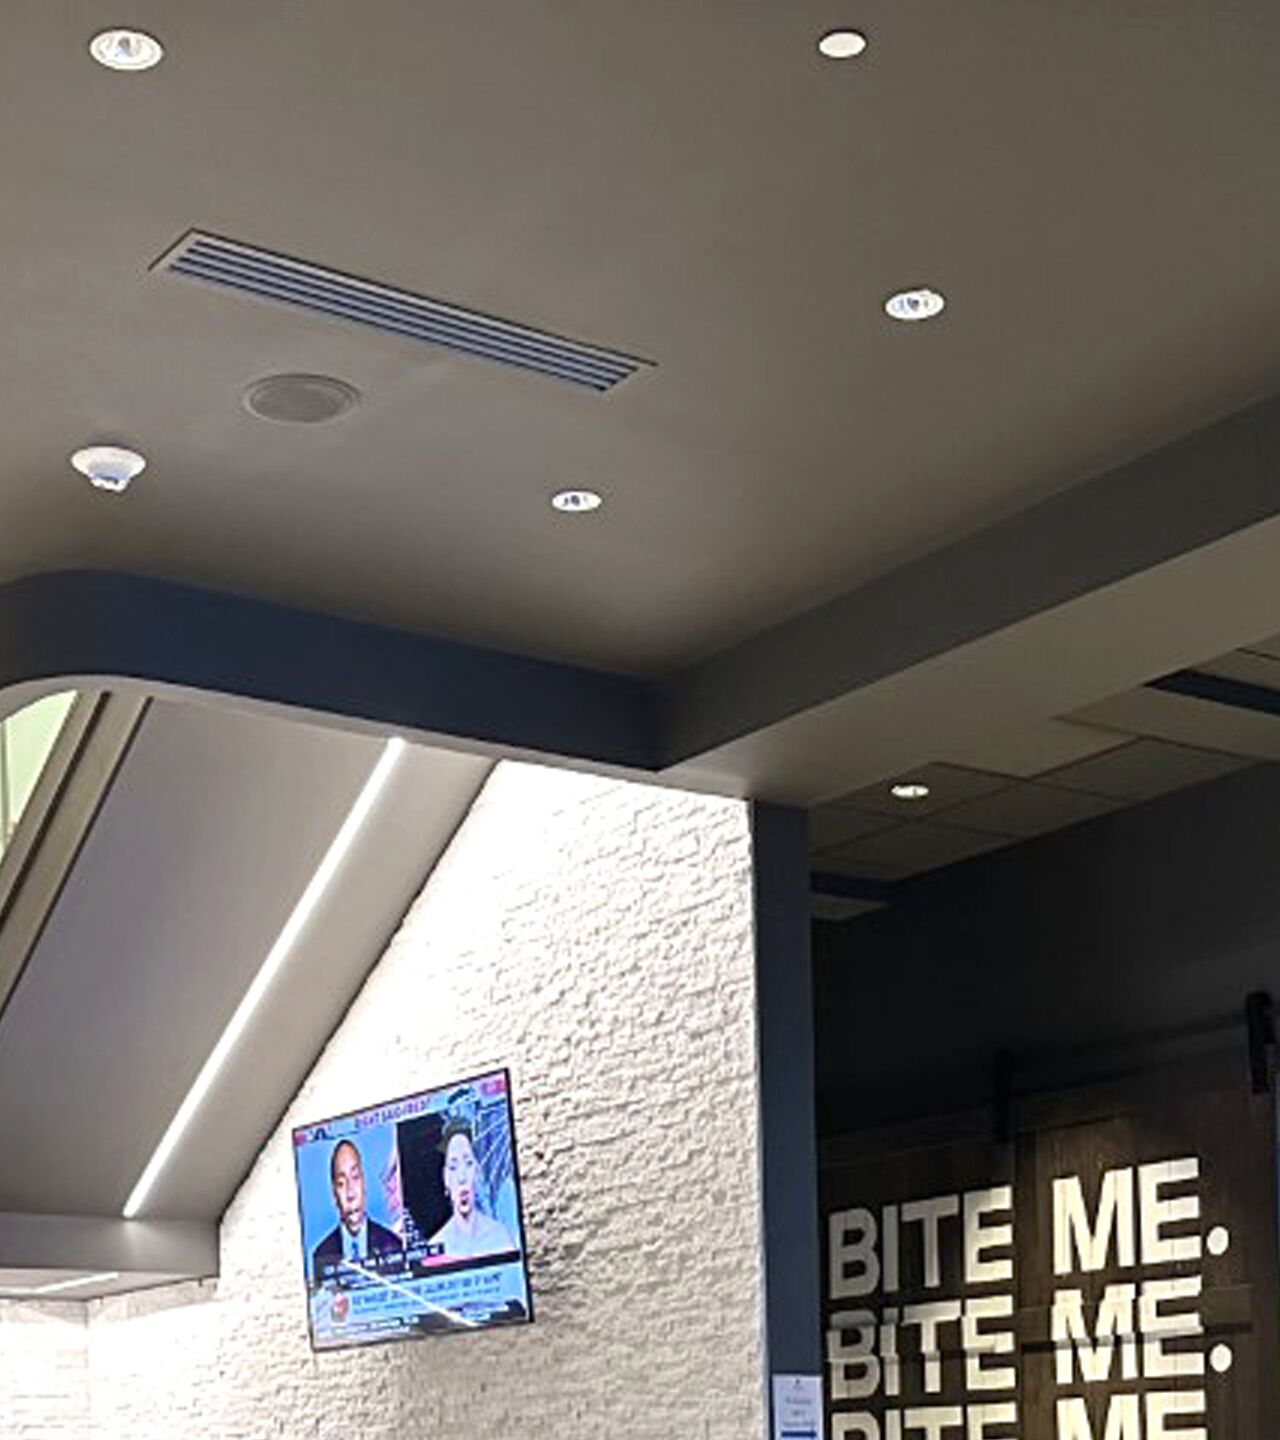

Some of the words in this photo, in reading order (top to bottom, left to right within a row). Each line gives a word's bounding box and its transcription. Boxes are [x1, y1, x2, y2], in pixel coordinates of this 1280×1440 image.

[828, 1185, 1014, 1300] BITE
[1052, 1157, 1229, 1275] ME.
[828, 1295, 1016, 1399] BITE
[1051, 1276, 1233, 1384] ME.
